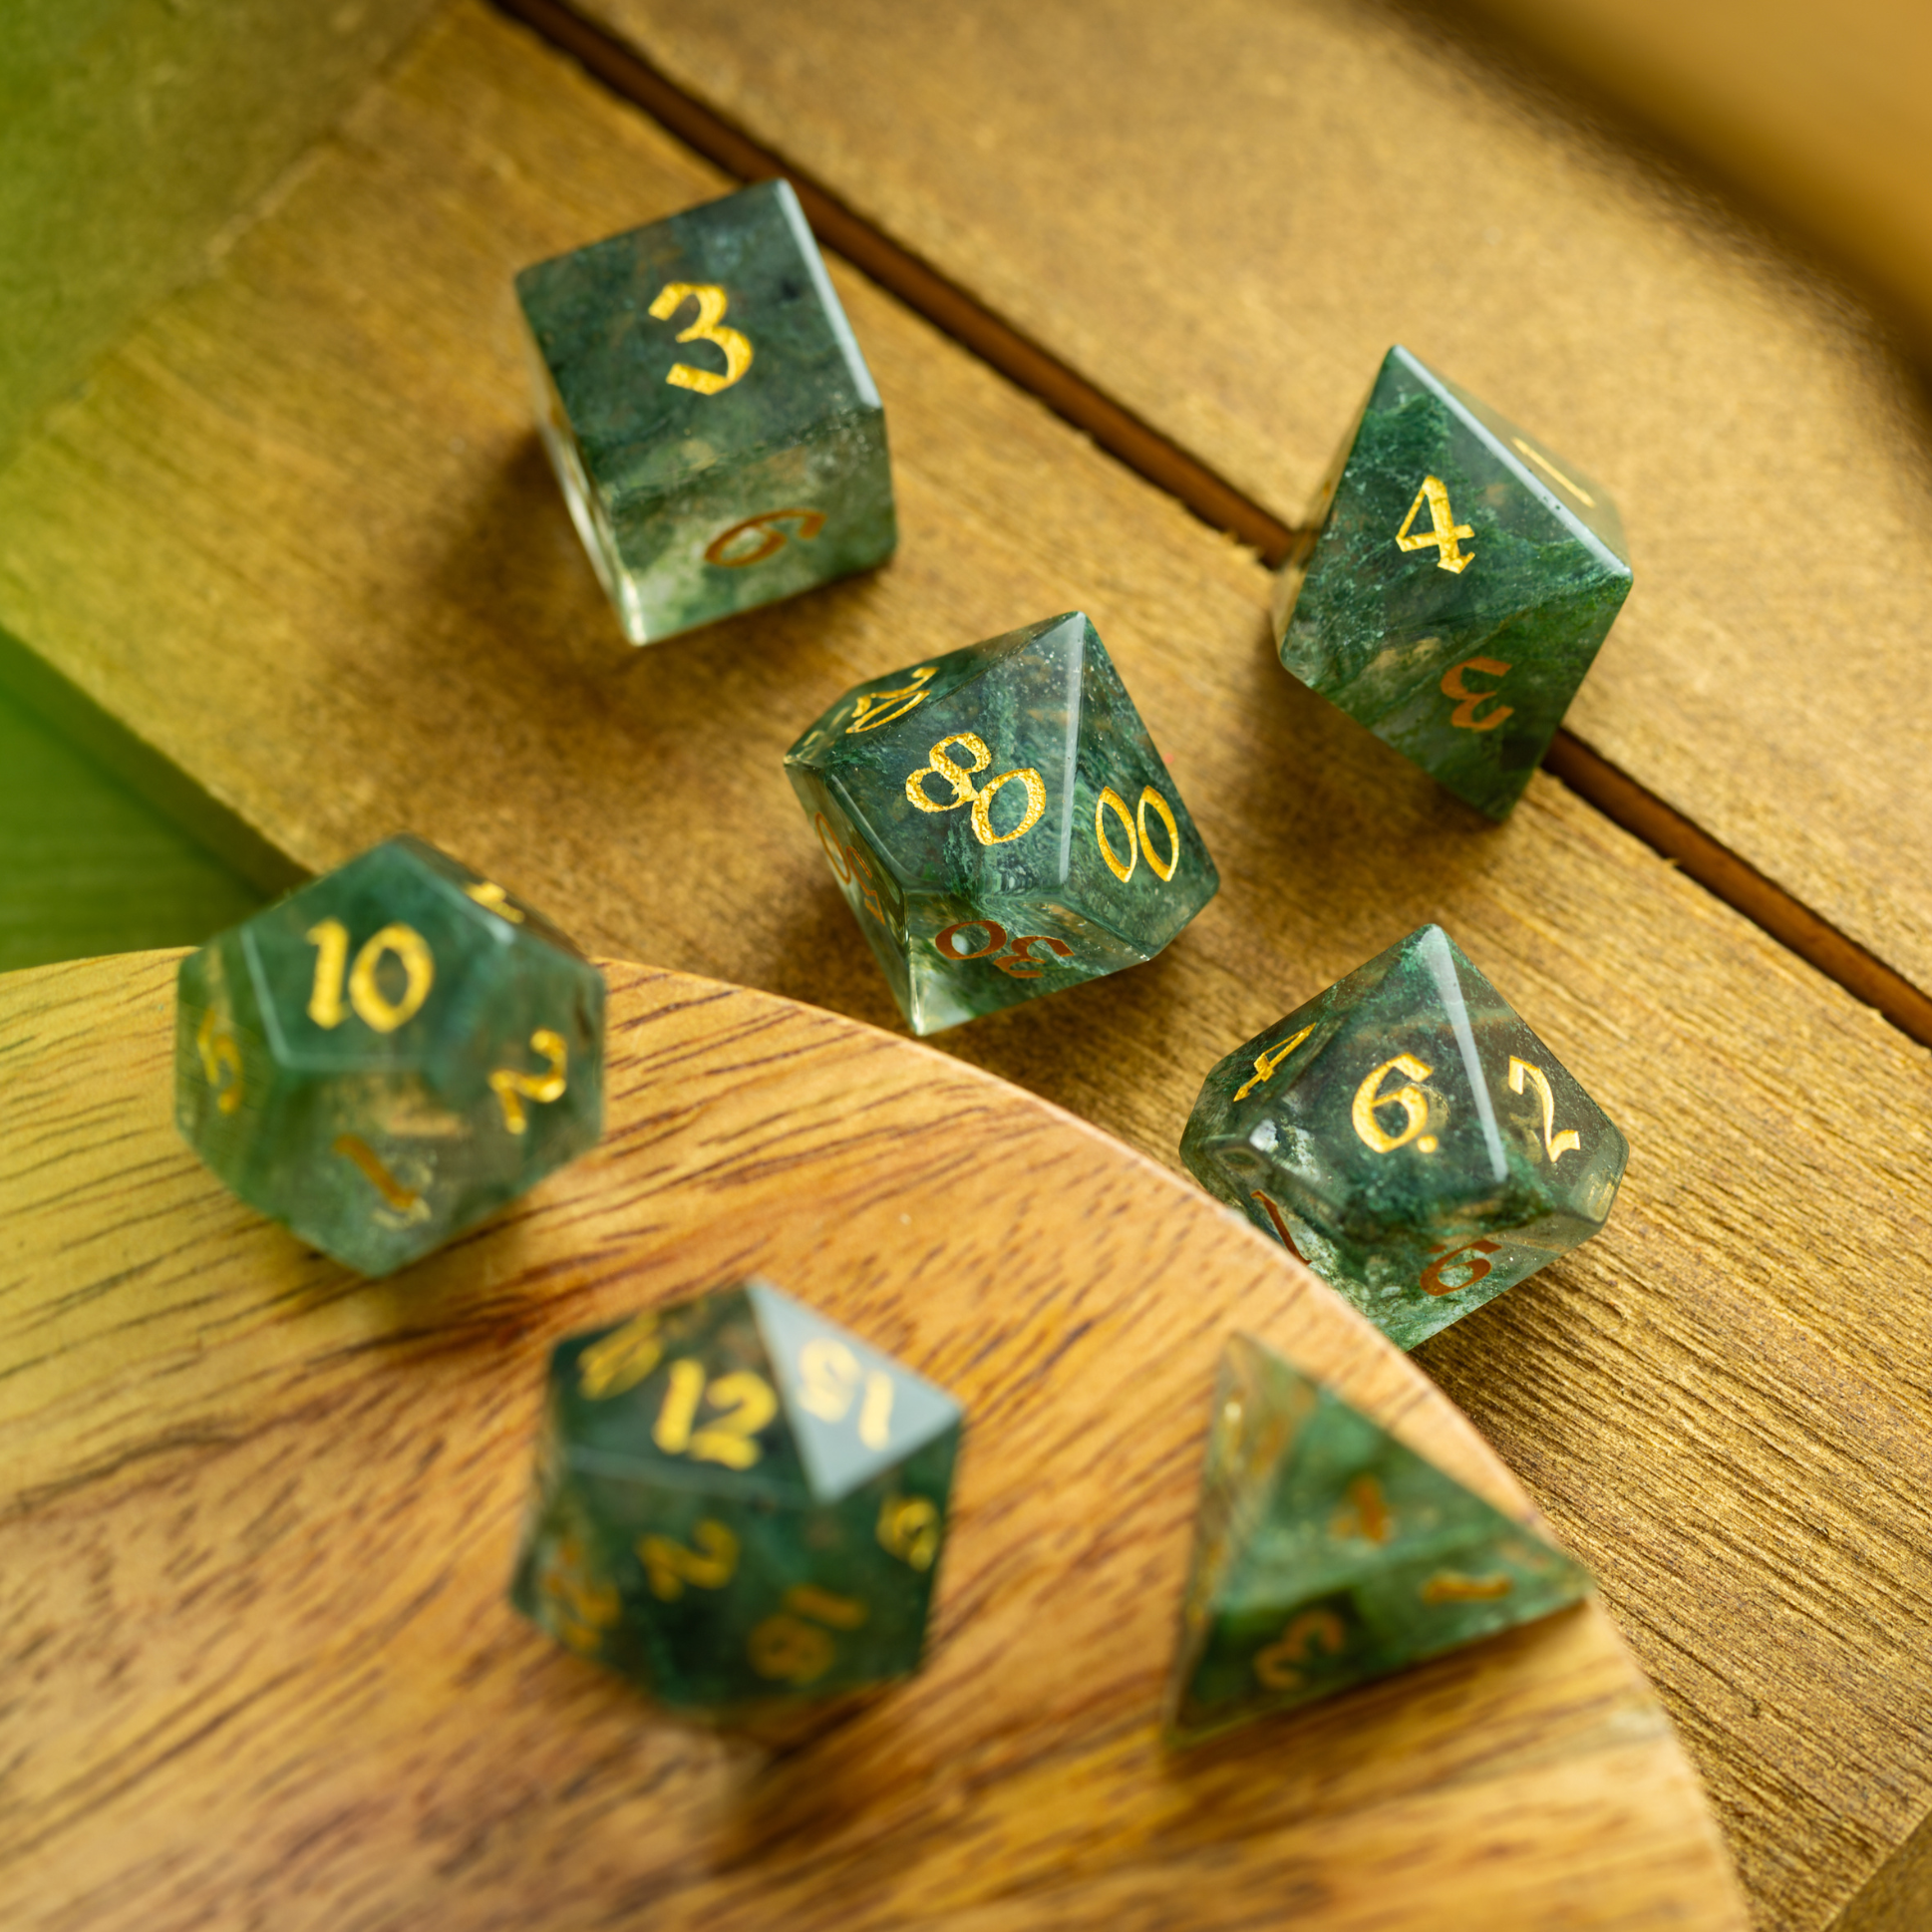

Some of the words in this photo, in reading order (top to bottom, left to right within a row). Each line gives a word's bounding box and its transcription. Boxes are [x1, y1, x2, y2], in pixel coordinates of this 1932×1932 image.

[649, 282, 754, 396] 3
[1397, 476, 1475, 574] 4
[1441, 655, 1514, 732] 3
[905, 732, 1047, 846] 80
[1095, 786, 1180, 883] 00
[305, 916, 436, 1034] 10
[934, 919, 1075, 979] 30
[488, 1028, 567, 1134] 2
[1233, 1022, 1317, 1103] 4
[1509, 1055, 1581, 1163] 2
[650, 1357, 779, 1471] 12
